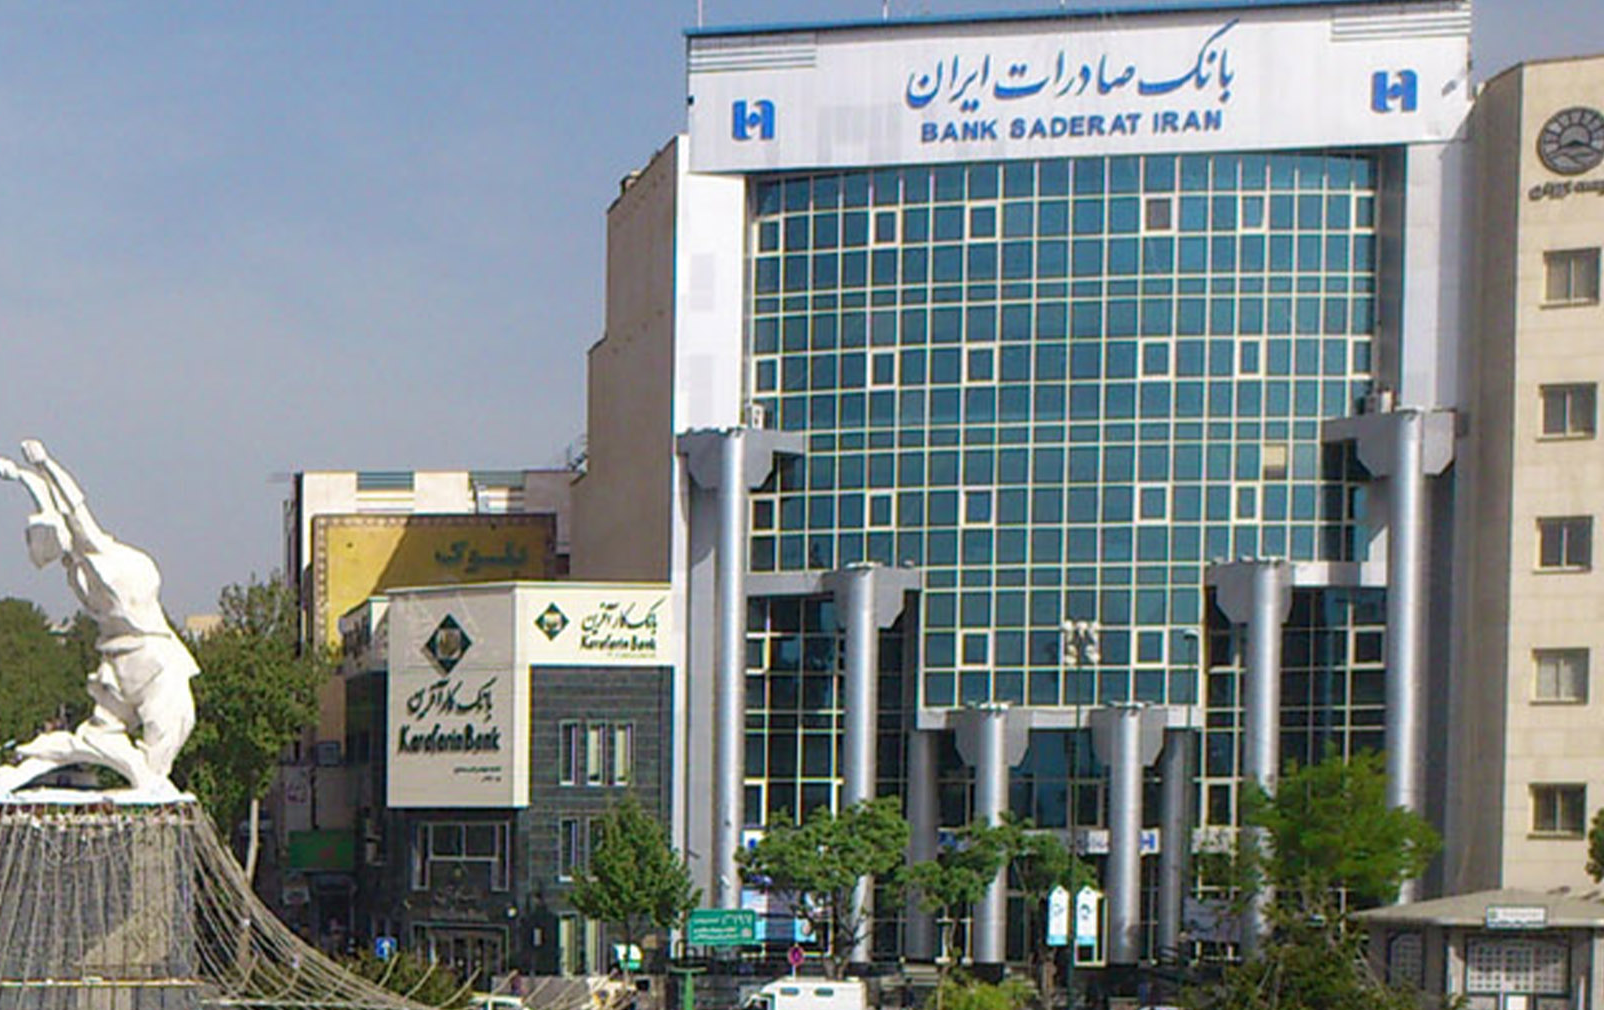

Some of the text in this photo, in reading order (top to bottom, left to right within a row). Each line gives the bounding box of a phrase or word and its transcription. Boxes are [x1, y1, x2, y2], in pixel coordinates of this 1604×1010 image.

[906, 18, 1239, 112] بانک صادرات ایران
[920, 109, 1223, 145] BANK SADERAT IRAN
[627, 596, 666, 635] بانک
[630, 634, 657, 652] Bank
[406, 677, 497, 723] بانک کارآفرین
[398, 722, 501, 756] Karafarin Bank
